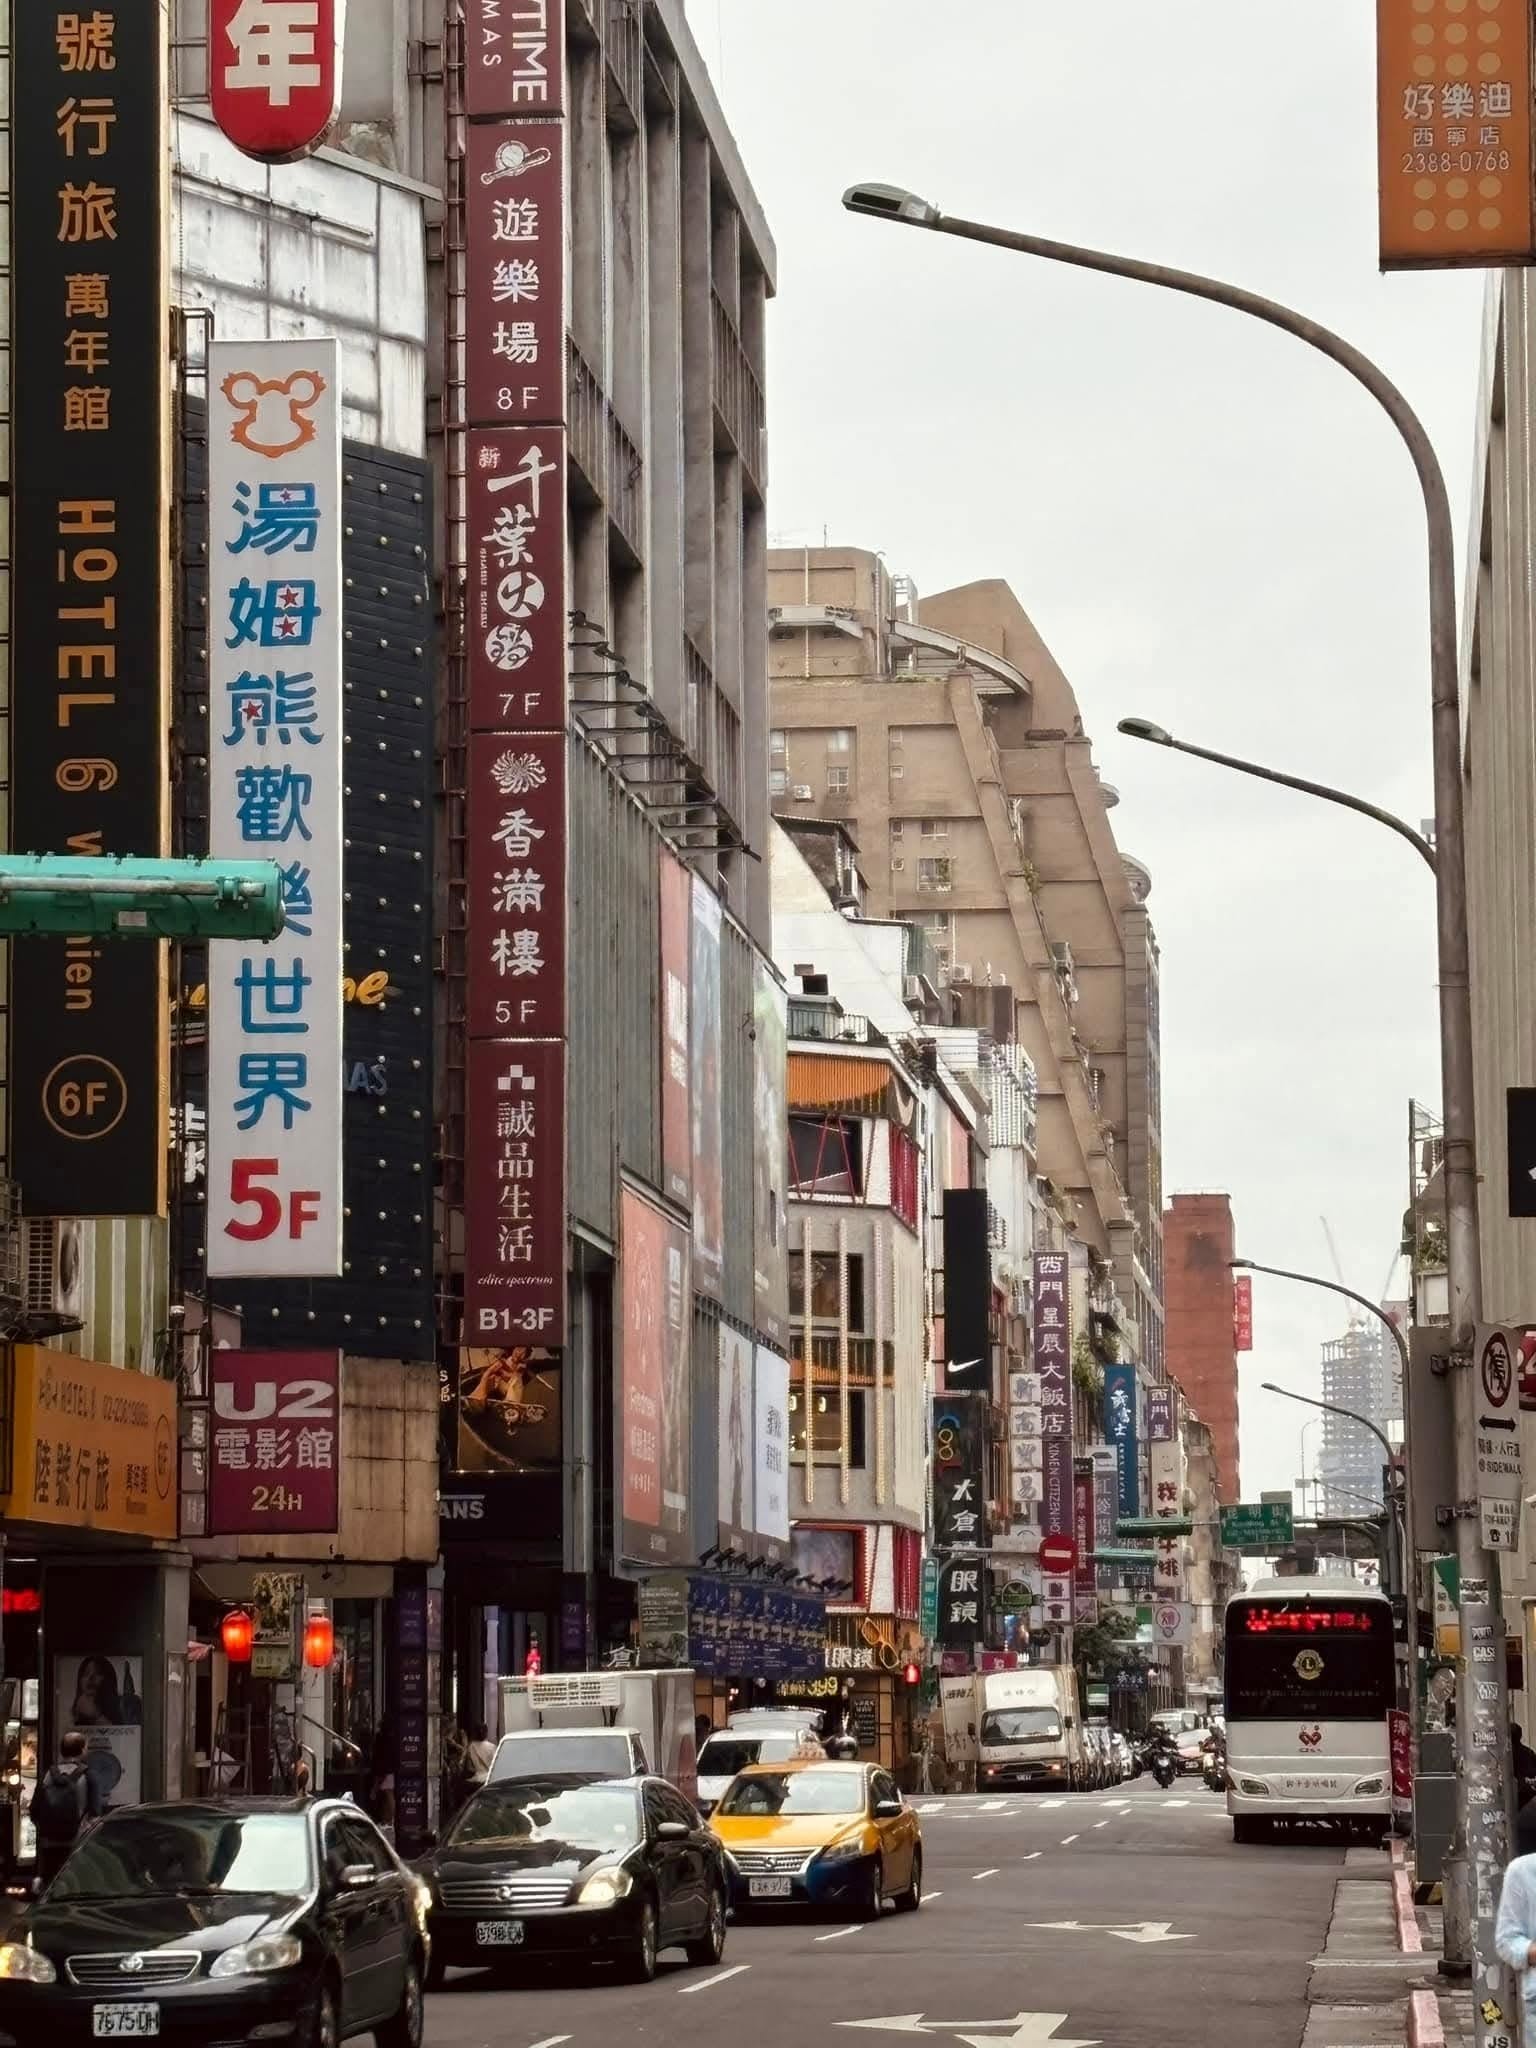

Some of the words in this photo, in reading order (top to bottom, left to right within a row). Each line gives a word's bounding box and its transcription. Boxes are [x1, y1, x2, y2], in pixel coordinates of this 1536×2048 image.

[1403, 81, 1512, 120] 好樂迪
[1402, 151, 1510, 173] 2388-0768
[492, 198, 539, 364] 遊樂場
[63, 273, 111, 431] 萬年館
[491, 808, 546, 977] 香滿樓
[495, 1000, 538, 1024] 5F
[59, 1082, 109, 1117] 6F
[224, 1158, 321, 1242] 5F
[496, 1101, 536, 1263] 誠品生活
[479, 1308, 555, 1331] B1-3F
[1037, 1256, 1067, 1434] 西門星辰大飯店
[214, 1380, 334, 1421] U2
[214, 1427, 334, 1472] 電影館
[251, 1485, 302, 1512] 24H
